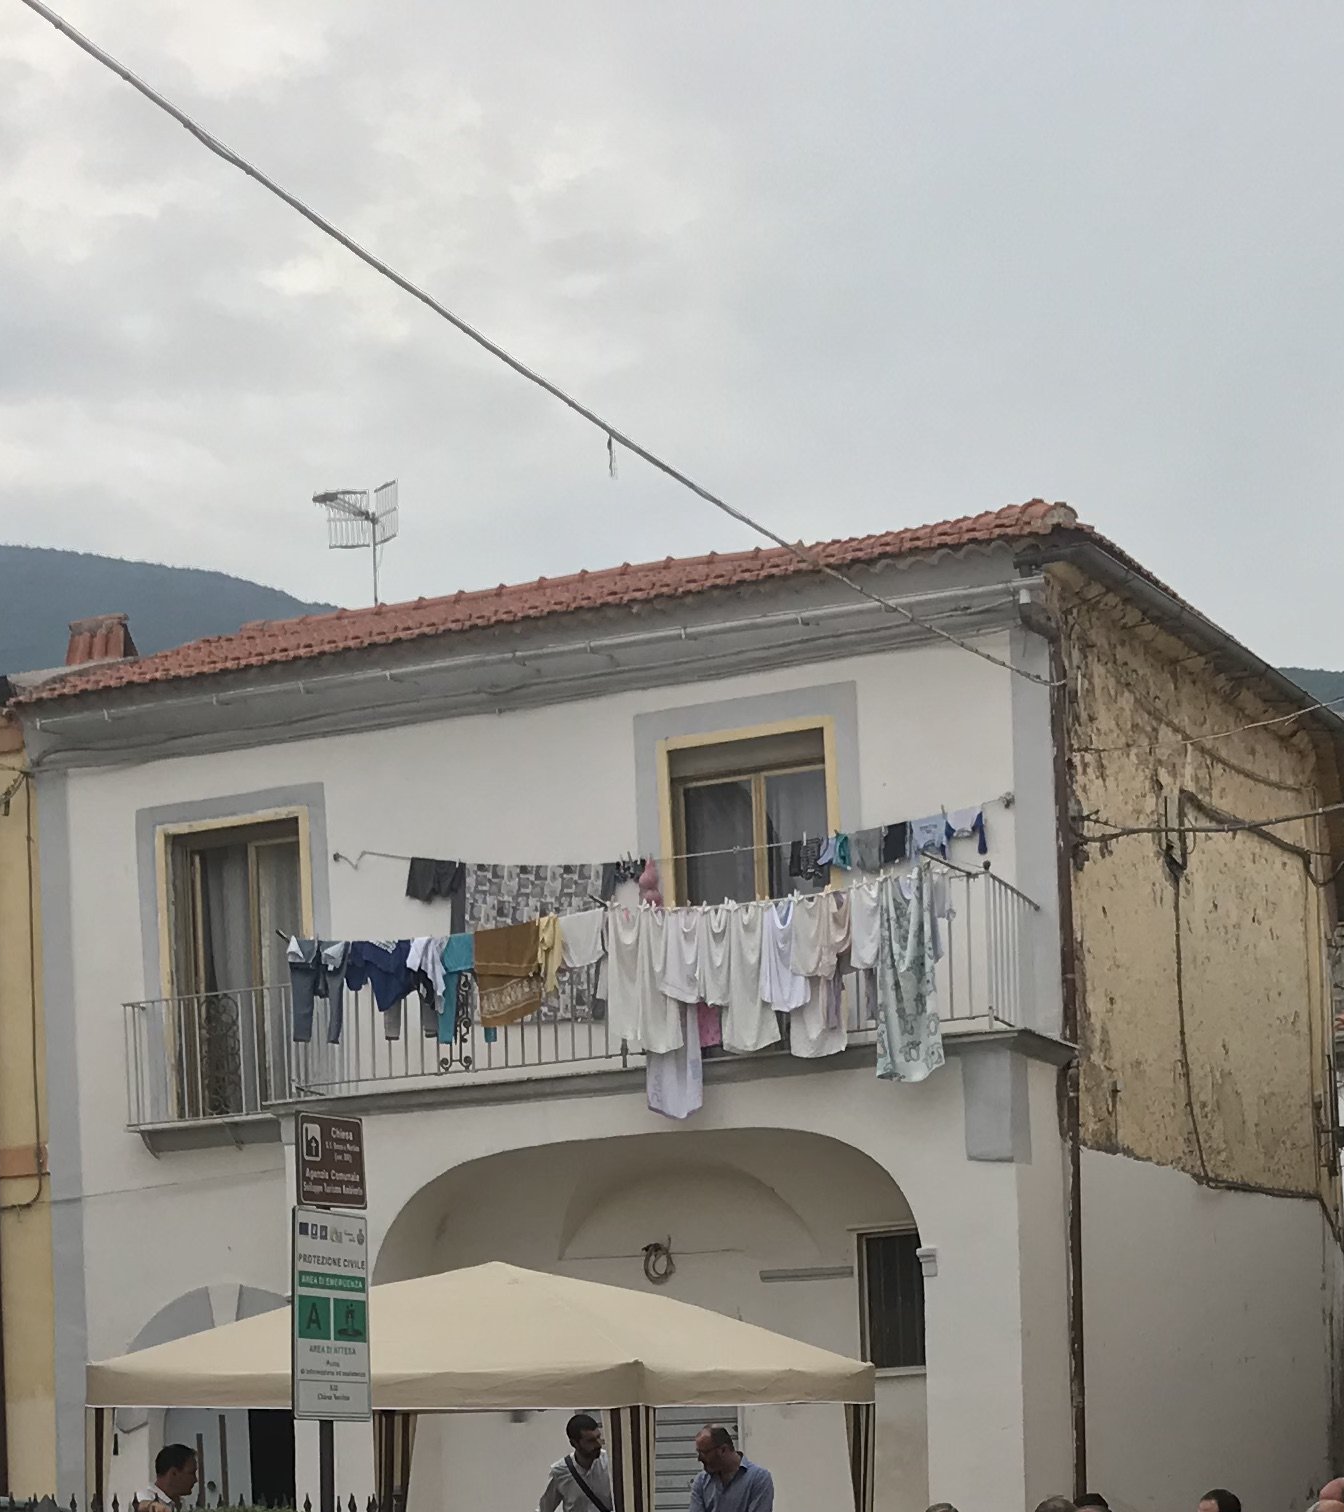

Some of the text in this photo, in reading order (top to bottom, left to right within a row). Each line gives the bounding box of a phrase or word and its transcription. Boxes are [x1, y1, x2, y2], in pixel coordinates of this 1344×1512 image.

[331, 1127, 353, 1141] Chiesa
[298, 1253, 365, 1270] PROTEZIONE CIVILE
[301, 1275, 363, 1289] AREA DI EMERGENZA
[306, 1302, 322, 1331] A
[309, 1345, 356, 1355] AREA DI ATTESA
